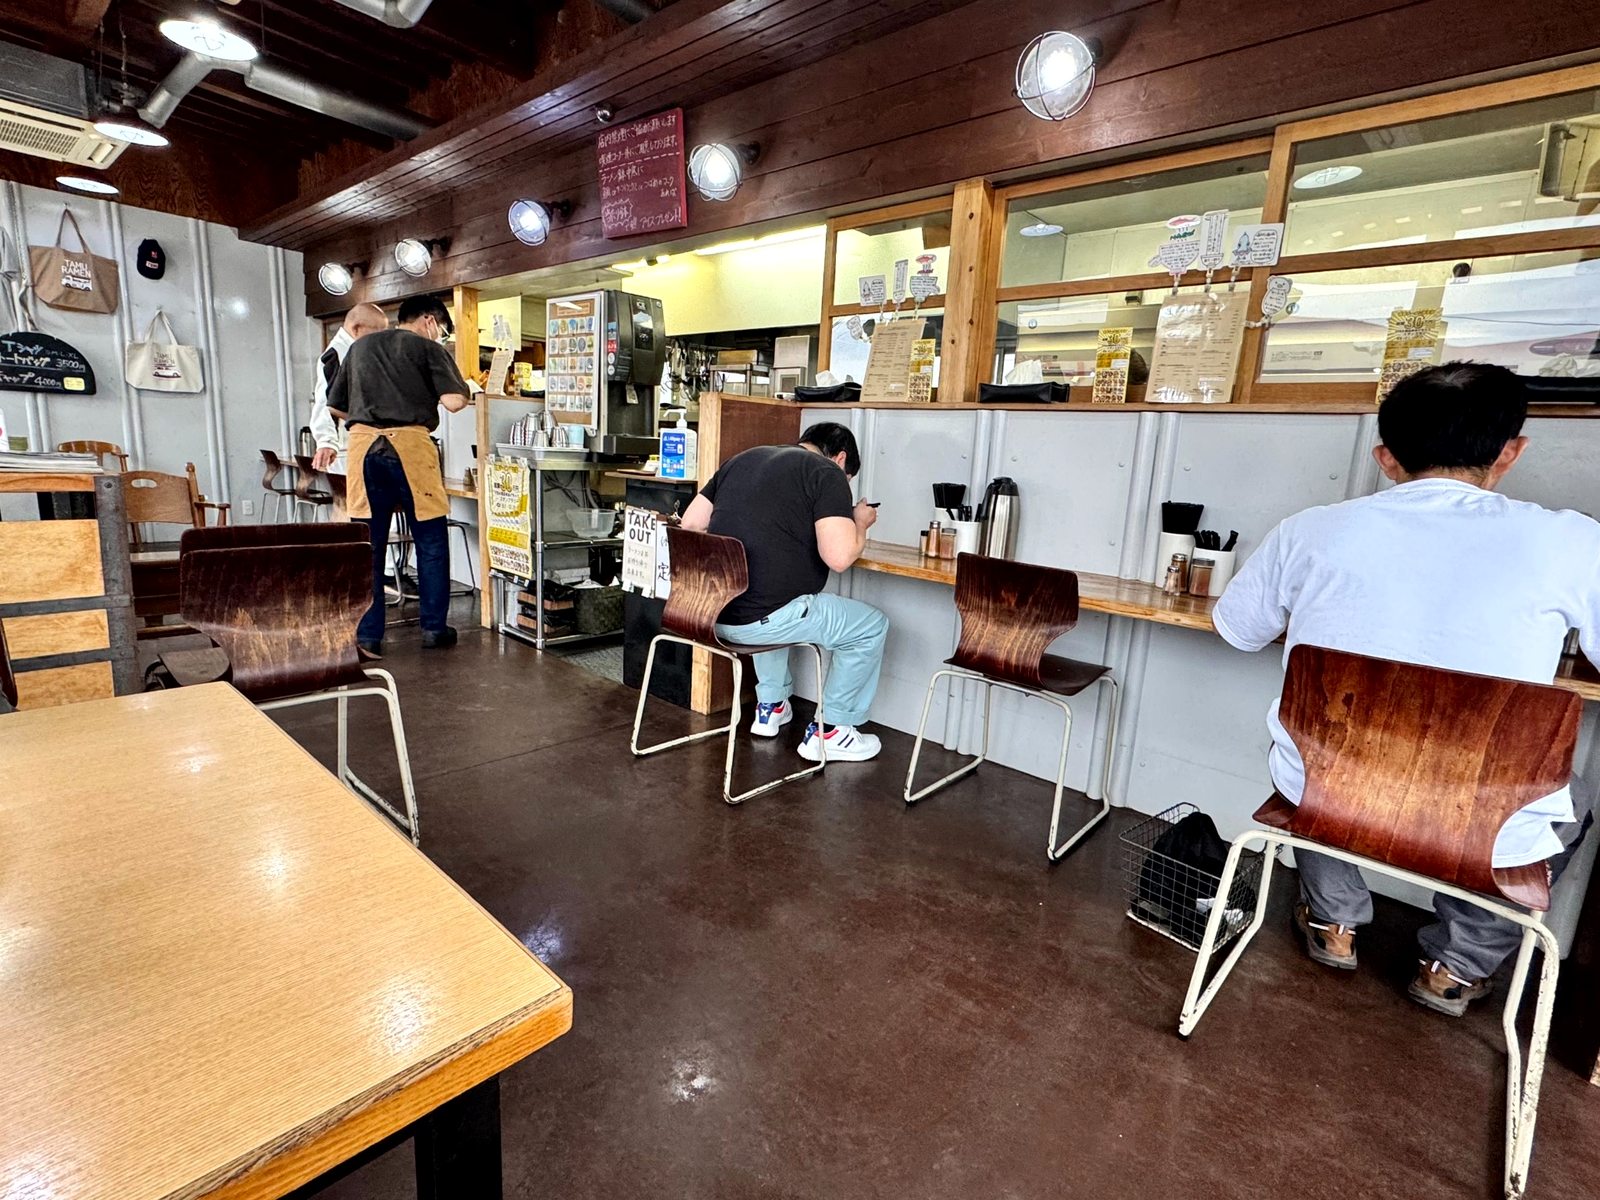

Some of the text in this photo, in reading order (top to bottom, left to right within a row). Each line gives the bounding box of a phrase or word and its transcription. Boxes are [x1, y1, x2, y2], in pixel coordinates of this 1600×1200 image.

[61, 266, 91, 278] RAMEN
[63, 259, 88, 271] TAMU
[628, 510, 656, 531] TAKE
[629, 527, 651, 544] OUT
